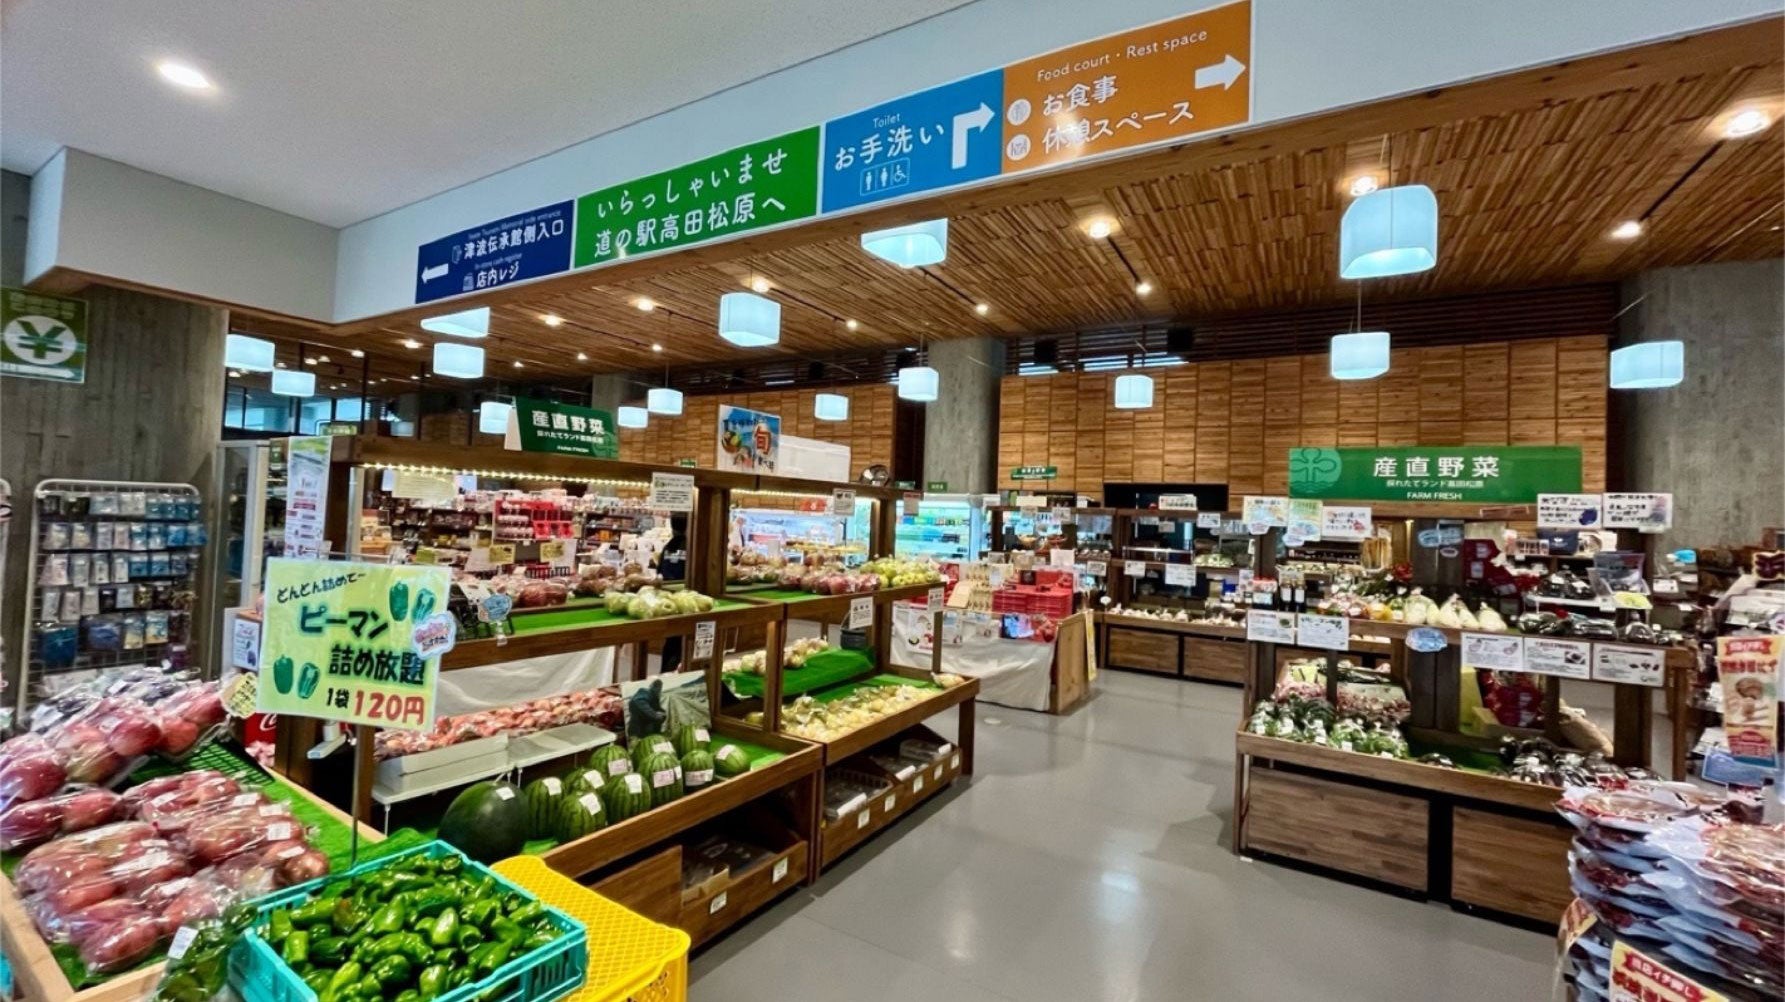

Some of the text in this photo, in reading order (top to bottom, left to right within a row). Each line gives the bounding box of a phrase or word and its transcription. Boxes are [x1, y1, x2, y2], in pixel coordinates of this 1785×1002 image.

[1038, 63, 1070, 82] Food
[1074, 54, 1110, 72] court
[1126, 42, 1159, 59] Rest
[1163, 30, 1208, 53] space
[1043, 74, 1119, 117] お食事
[873, 113, 901, 128] Toilet
[834, 124, 944, 171] お手洗い
[597, 148, 788, 219] いらっしゃいませ
[464, 219, 564, 260] 津波伝承館側入口
[594, 192, 786, 258] 道の駅高田松原へ
[476, 261, 520, 289] 店内レジ
[532, 410, 605, 434] 産直野菜
[1373, 456, 1499, 478] 産直野菜
[1406, 492, 1463, 500] FARM FRESH
[301, 605, 389, 639] ピーマン
[328, 644, 426, 686] 詰め放題
[327, 688, 425, 725] 1袋 120円
